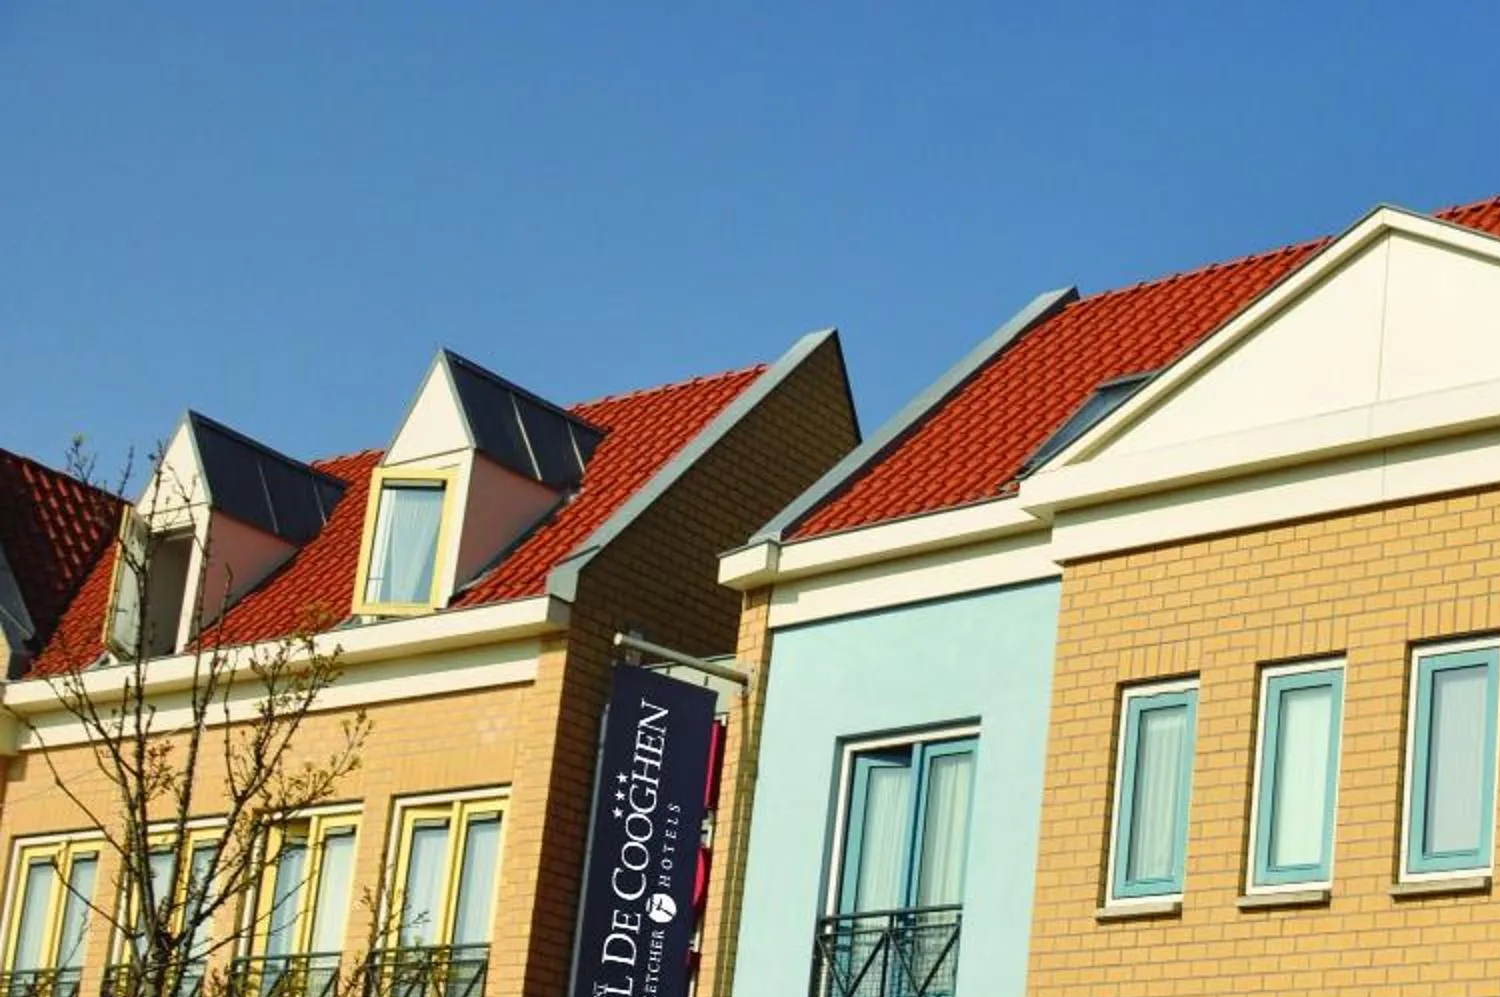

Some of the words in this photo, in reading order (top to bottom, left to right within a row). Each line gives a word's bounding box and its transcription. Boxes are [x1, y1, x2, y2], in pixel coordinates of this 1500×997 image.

[611, 698, 670, 900] COOGHEN
[658, 803, 681, 887] HOTELS
[602, 909, 642, 966] DE
